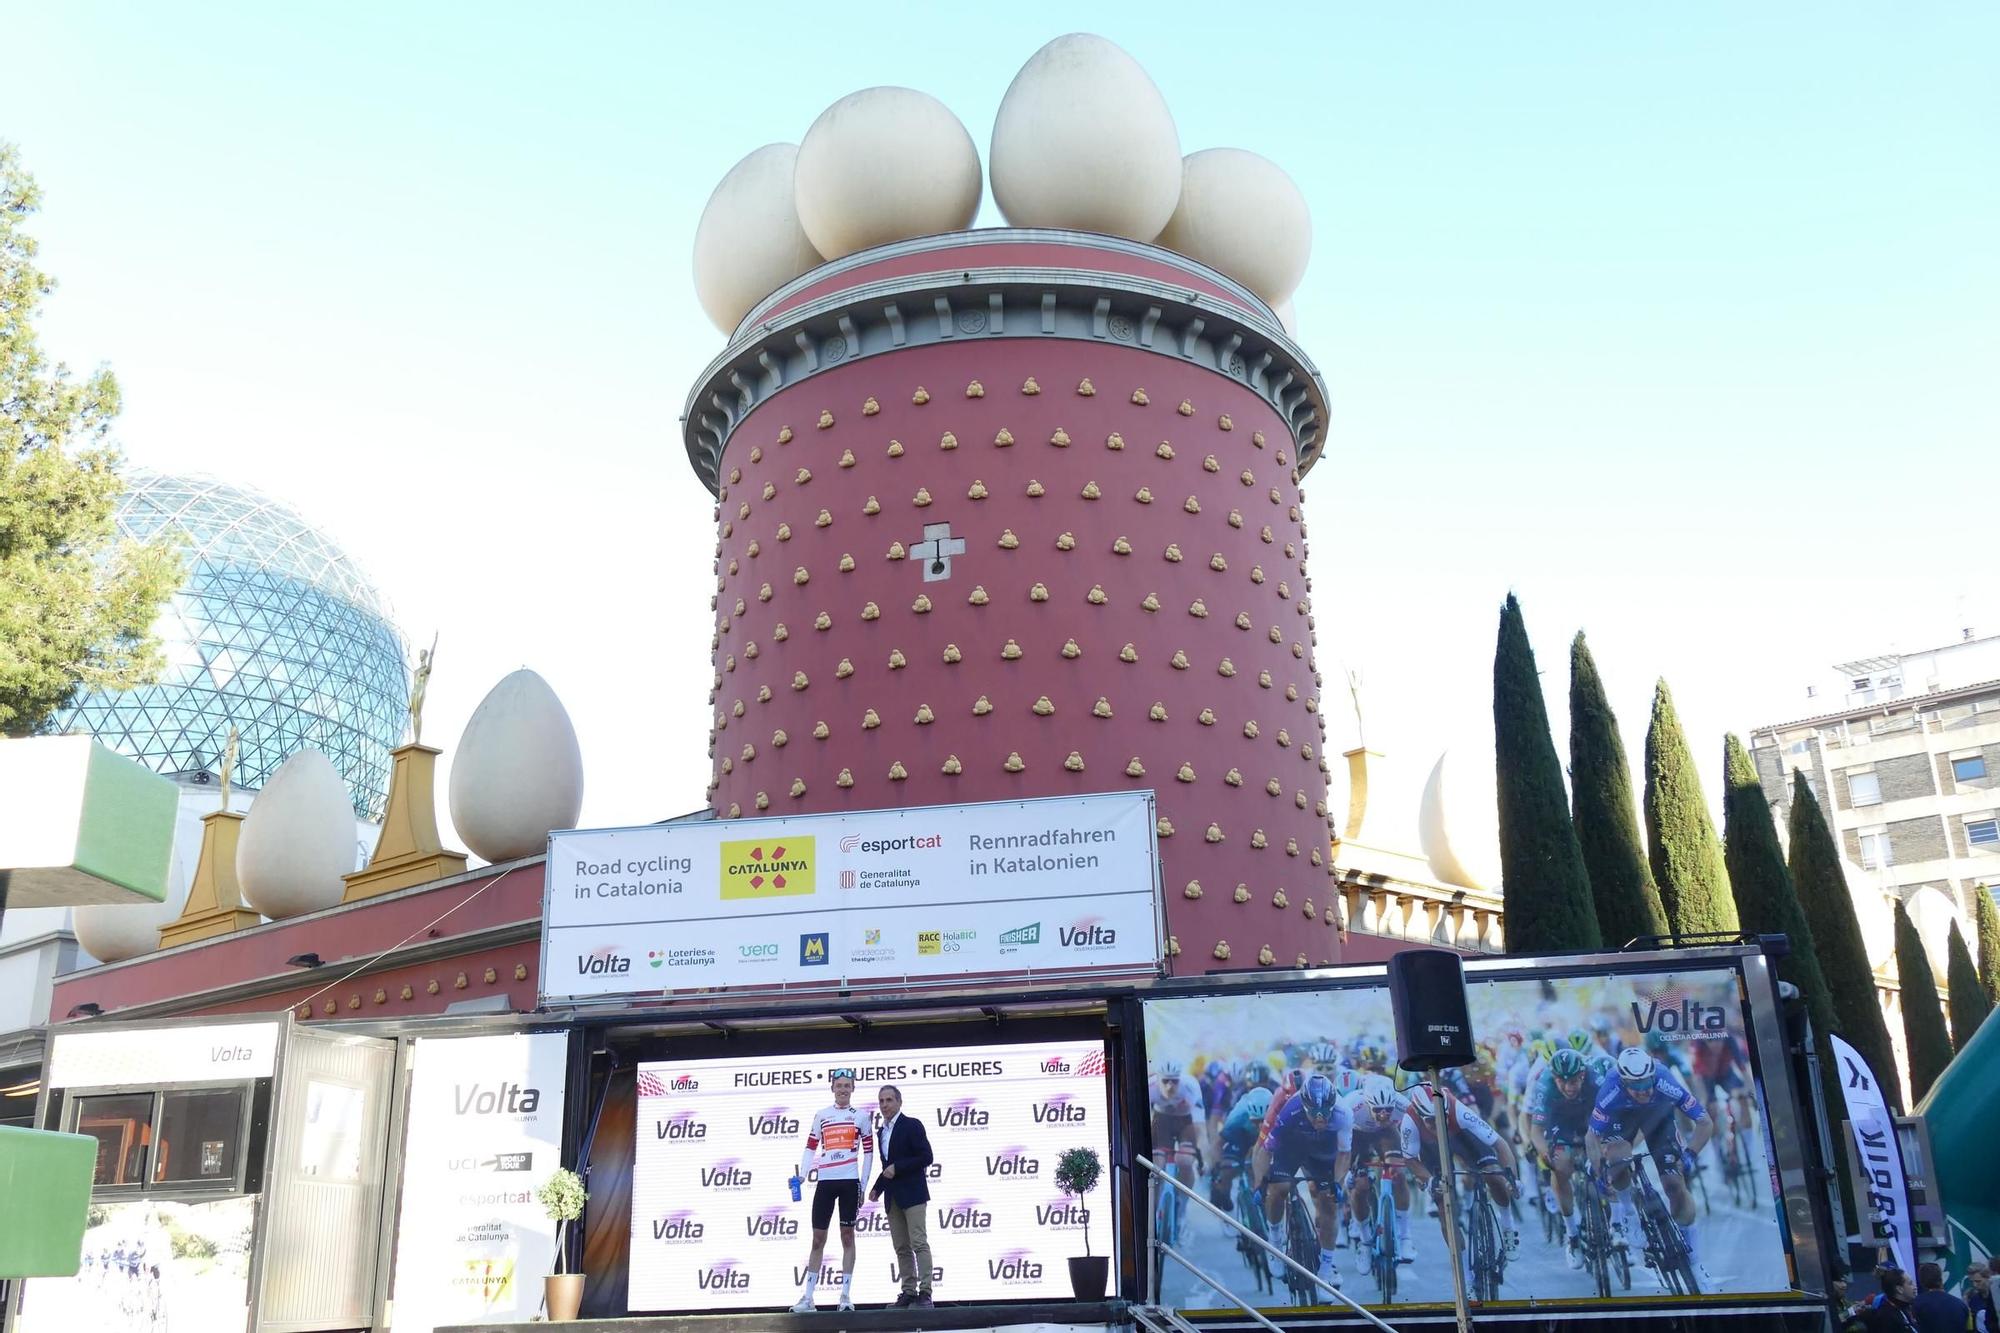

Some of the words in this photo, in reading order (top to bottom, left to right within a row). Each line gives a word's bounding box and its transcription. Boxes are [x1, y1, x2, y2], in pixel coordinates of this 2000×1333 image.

[861, 834, 942, 855] esportcat
[970, 826, 1116, 851] Rennradfahren
[576, 859, 622, 877] Road
[627, 856, 692, 877] cycling
[728, 860, 808, 876] CATALUNYA
[860, 869, 911, 880] Generalitat
[970, 858, 988, 876] in
[994, 853, 1099, 875] Katalonien
[575, 884, 591, 900] in
[596, 879, 683, 898] Catalonia
[860, 881, 872, 889] de
[874, 879, 920, 889] Catalunya
[918, 933, 940, 942] RACC
[1059, 925, 1116, 947] Volta
[668, 957, 716, 967] Catalunya
[669, 948, 706, 958] Loteries
[578, 954, 631, 975] Volta
[1631, 999, 1726, 1034] Volta
[210, 1046, 253, 1063] Volta
[734, 1070, 813, 1088] FIGUERES
[828, 1065, 907, 1083] FUERES
[922, 1061, 1003, 1079] FIGUERES
[1040, 1059, 1070, 1073] Volta
[670, 1079, 699, 1090] Volta
[454, 1082, 541, 1116] Volta
[937, 1106, 990, 1127] Volta
[1033, 1102, 1086, 1123] Volta
[657, 1119, 707, 1140] Volta
[748, 1115, 800, 1136] Volta
[448, 1158, 477, 1171] UCI
[986, 1155, 1039, 1176] Volta
[701, 1167, 752, 1187] Volta
[856, 1212, 891, 1232] olta
[938, 1208, 992, 1230] Volta
[1036, 1204, 1091, 1226] Volta
[653, 1219, 704, 1240] Volta
[747, 1215, 799, 1237] Volta
[468, 1232, 509, 1243] Catalunya
[698, 1269, 750, 1290] Volta
[794, 1265, 843, 1286] Vlta
[988, 1258, 1043, 1280] Volta
